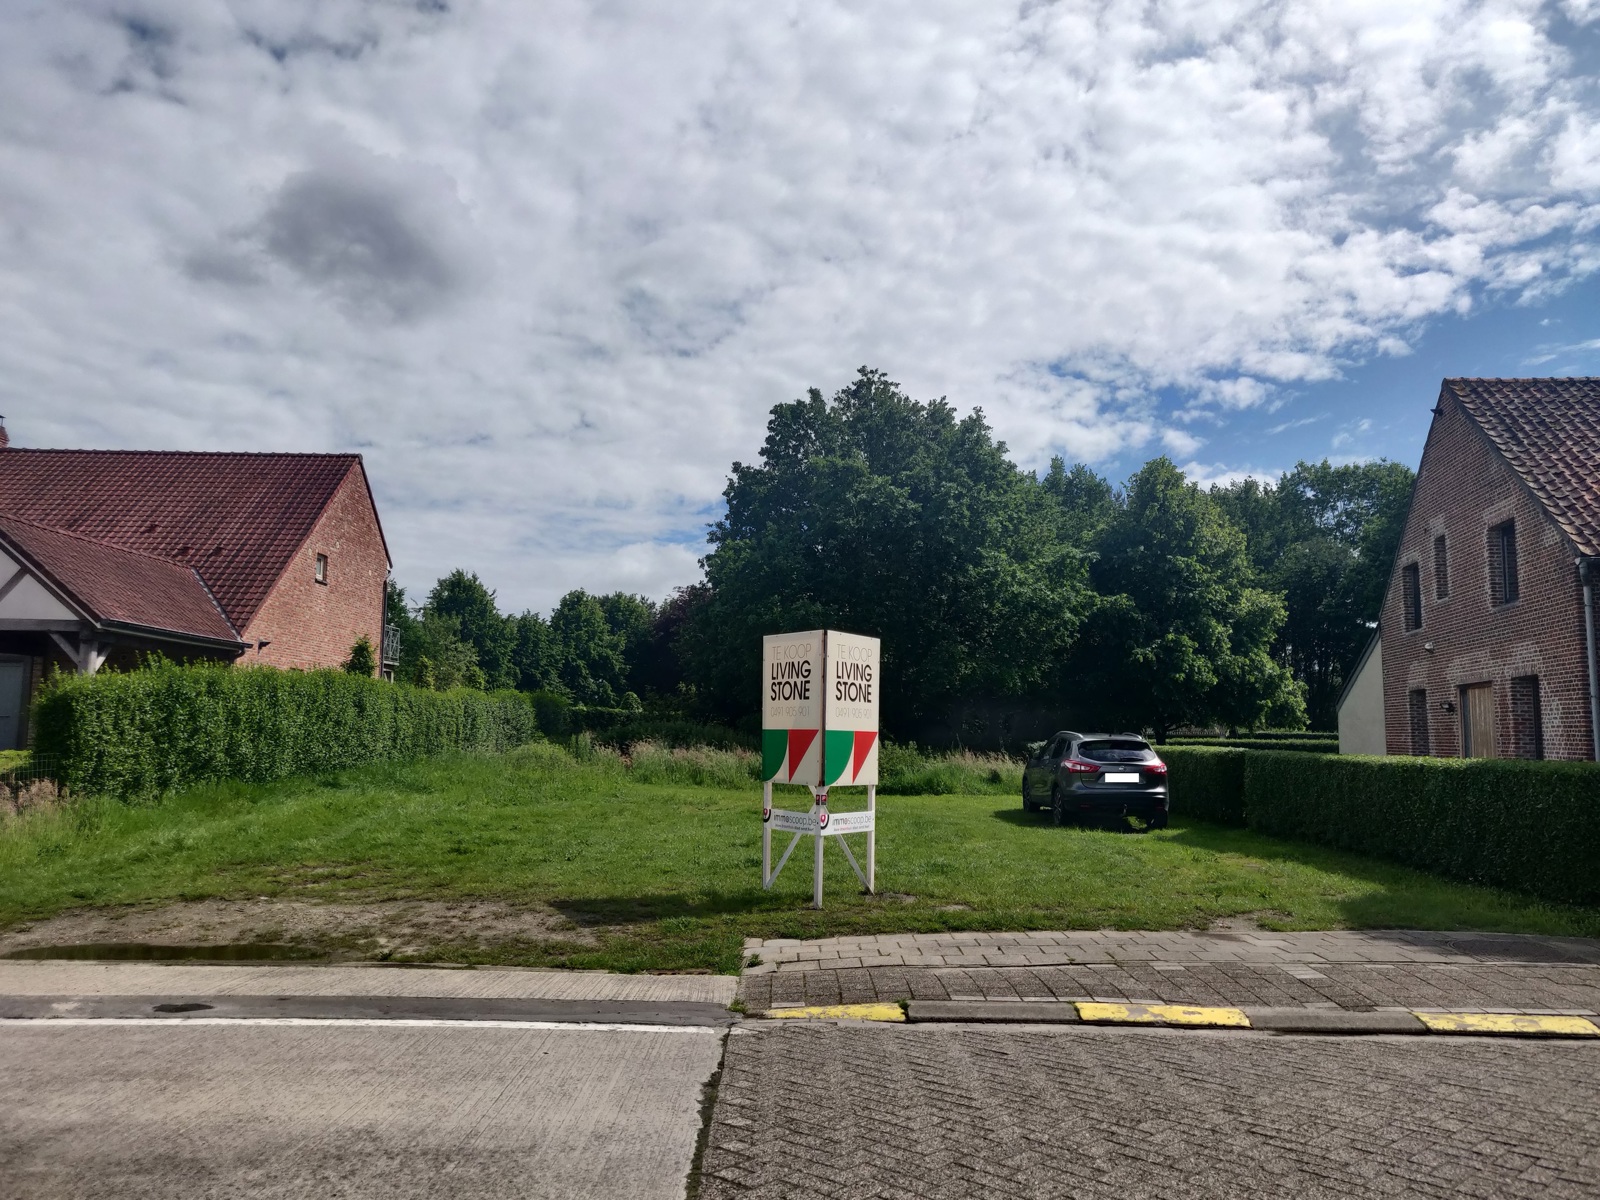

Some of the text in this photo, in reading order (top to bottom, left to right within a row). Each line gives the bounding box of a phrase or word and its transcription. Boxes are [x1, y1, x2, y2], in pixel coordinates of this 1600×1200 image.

[772, 643, 812, 660] TE KOOP
[837, 644, 872, 662] TE KOOP
[771, 660, 811, 680] LIVING
[836, 661, 872, 682] LIVING
[770, 680, 810, 701] STONE
[835, 681, 872, 703] STONE
[773, 811, 817, 826] immoscoop.be
[832, 813, 872, 826] immoscoop.be
